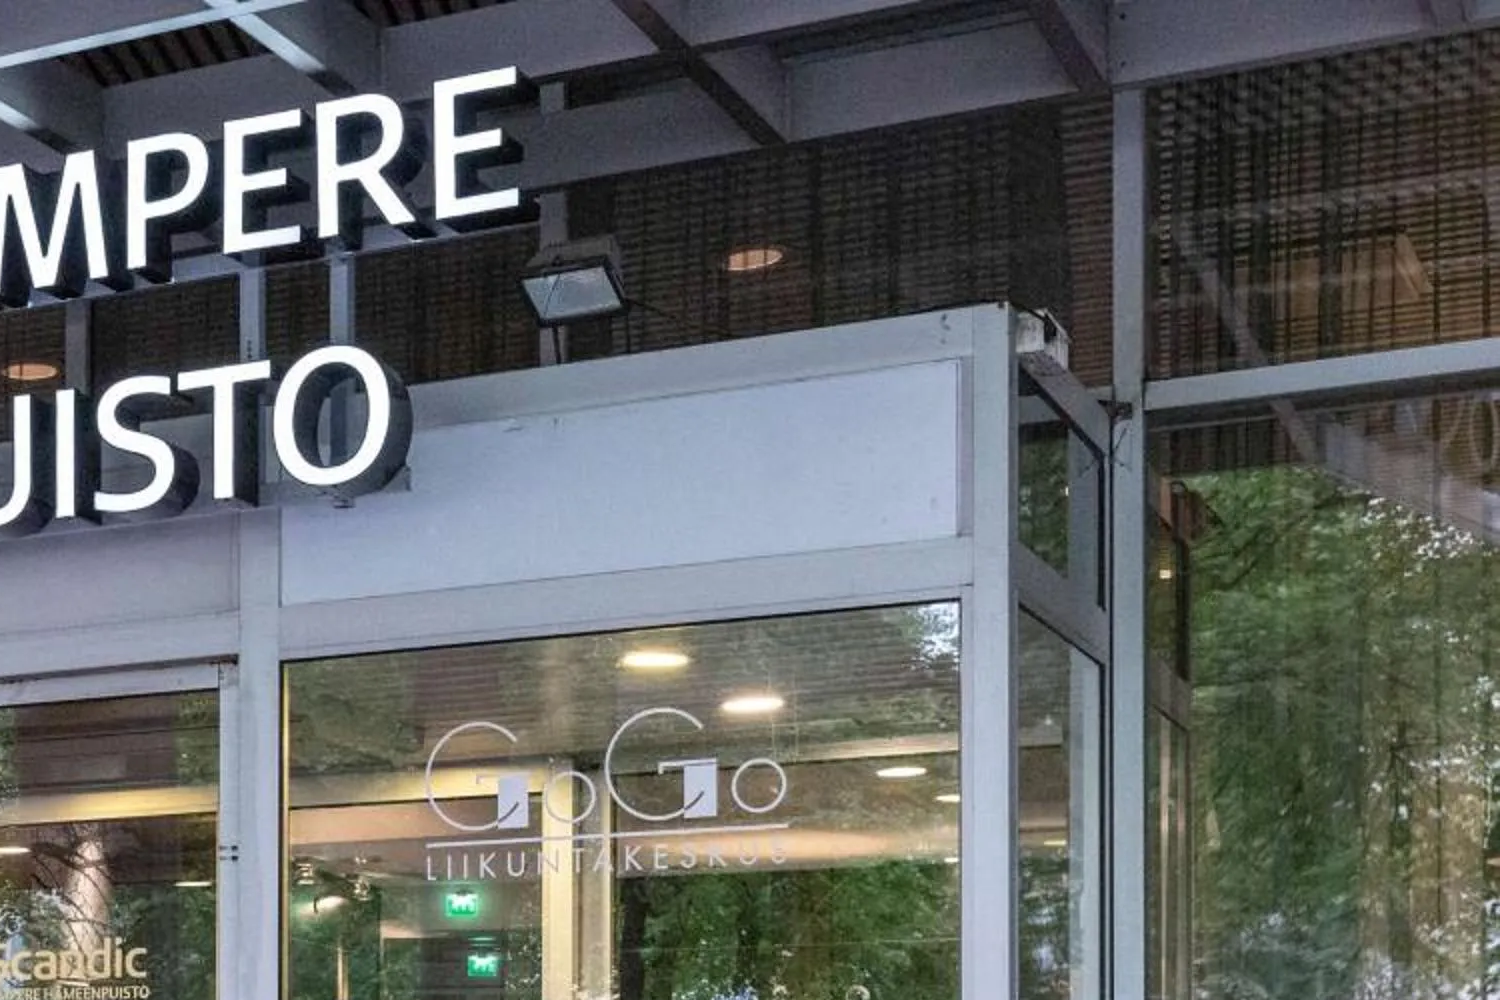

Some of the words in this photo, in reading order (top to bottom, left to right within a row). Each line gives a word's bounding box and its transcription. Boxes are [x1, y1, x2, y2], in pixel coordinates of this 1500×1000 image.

[426, 708, 787, 830] GoGo
[426, 839, 787, 882] LIIKUNTAKESKUS
[43, 984, 150, 1000] HÄMEENPUISTO
